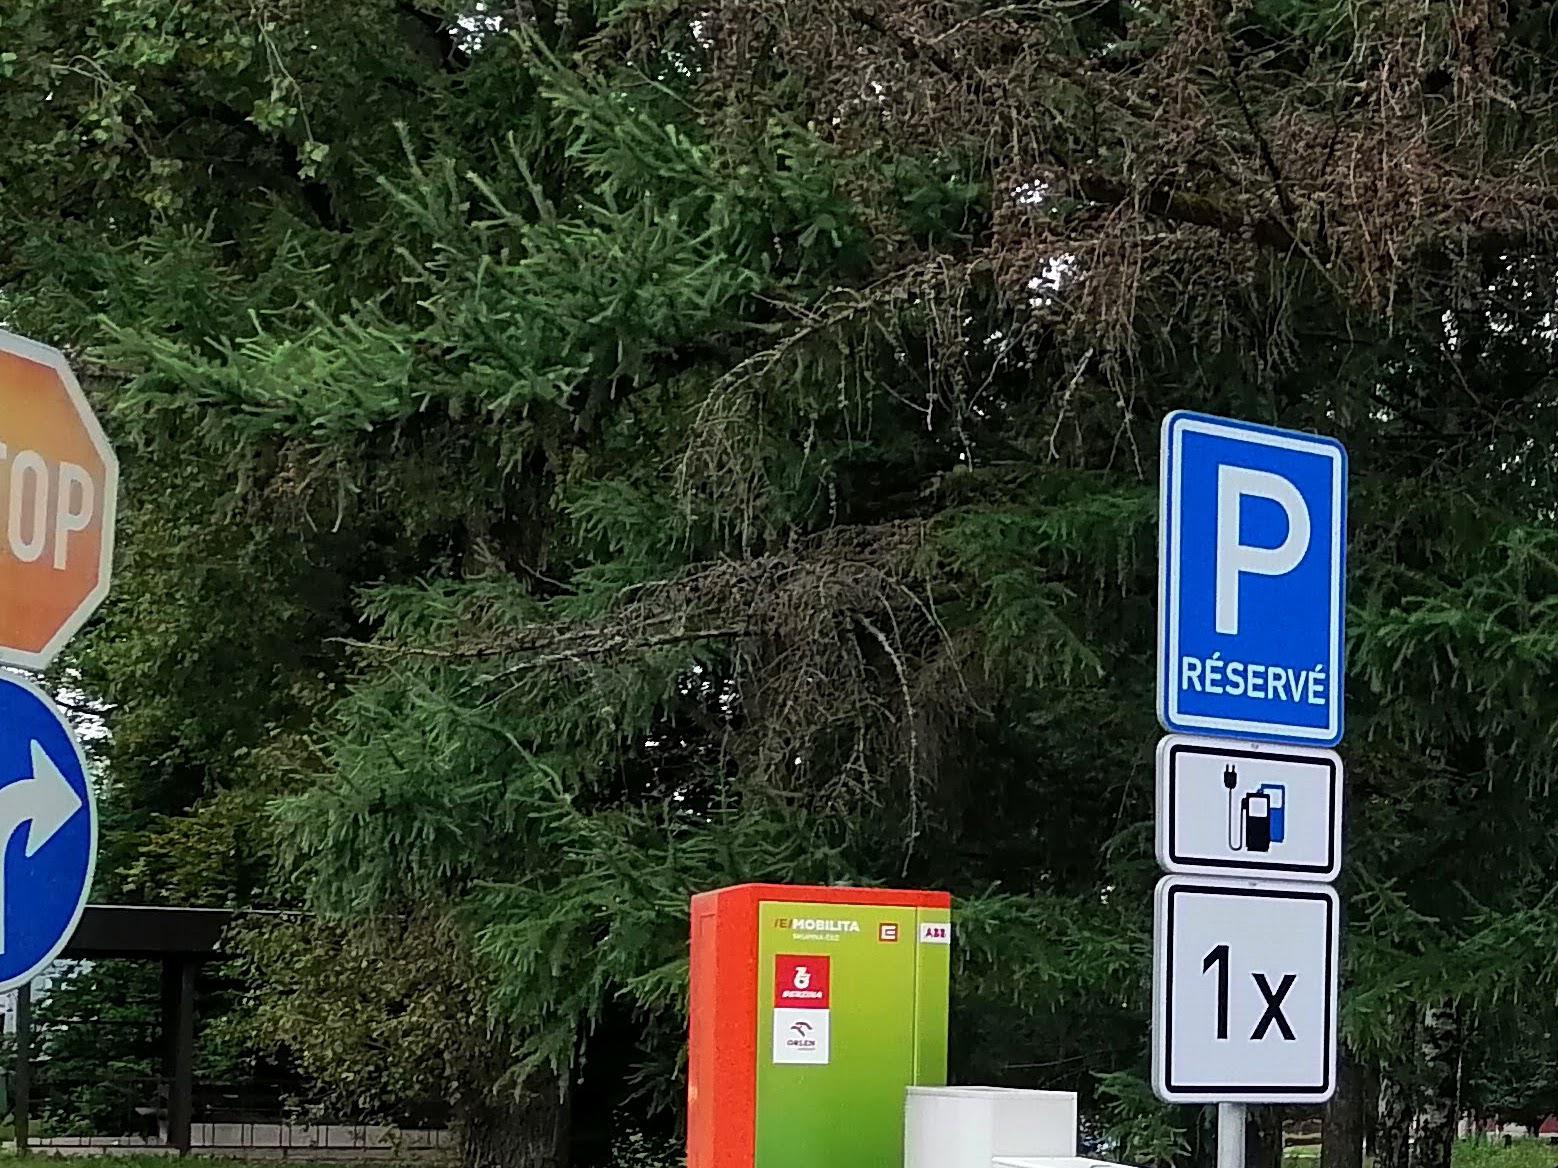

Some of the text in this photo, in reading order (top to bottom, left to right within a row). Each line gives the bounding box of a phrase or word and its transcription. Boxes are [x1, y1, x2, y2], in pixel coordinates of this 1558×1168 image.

[0, 441, 94, 570] OP
[1215, 463, 1311, 635] P
[1182, 651, 1326, 705] RÉSERVÉ
